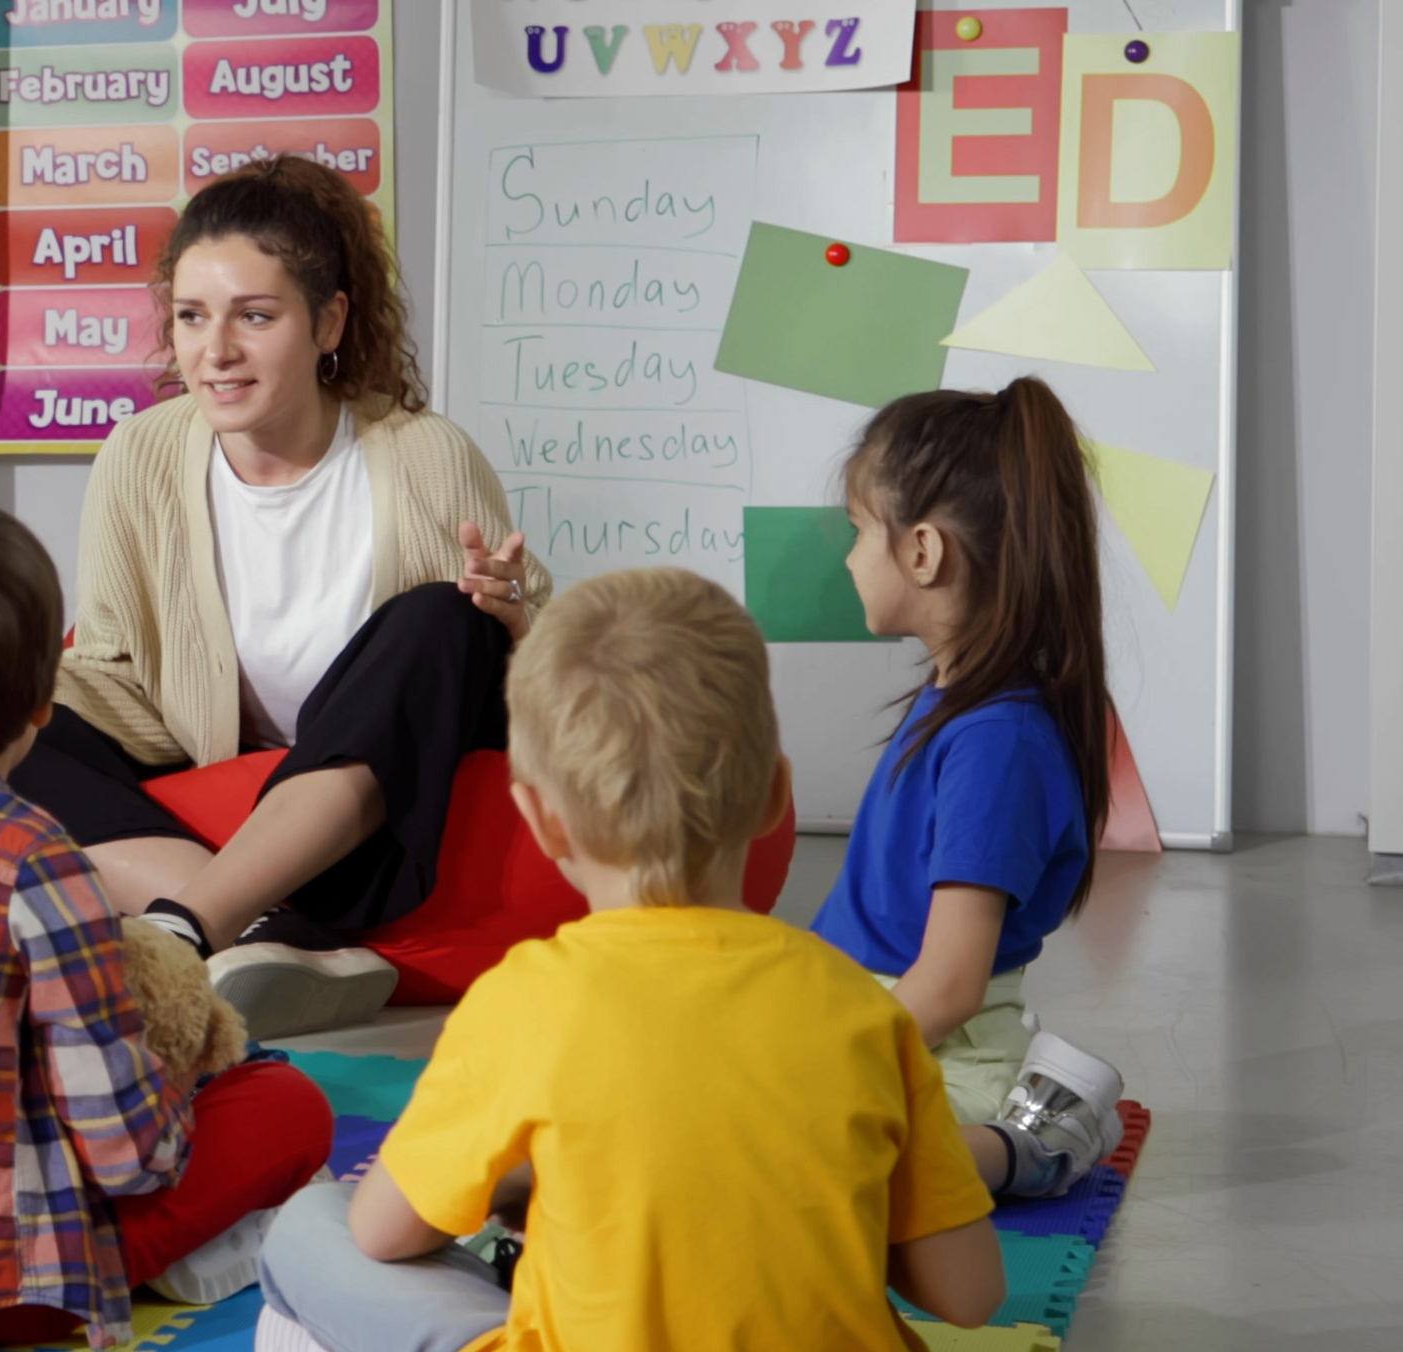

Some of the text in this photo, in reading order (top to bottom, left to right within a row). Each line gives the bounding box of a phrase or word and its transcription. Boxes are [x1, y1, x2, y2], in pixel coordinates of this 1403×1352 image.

[5, 0, 161, 26] January
[209, 54, 354, 99] August
[21, 143, 375, 186] March Sepber
[501, 146, 716, 241] Sunday
[32, 225, 139, 280] April
[500, 258, 700, 321] Monday
[43, 309, 129, 354] May
[503, 334, 698, 406] Tuesday
[28, 389, 136, 429] June
[505, 418, 739, 469] Wednesday
[505, 486, 745, 563] Thursday
